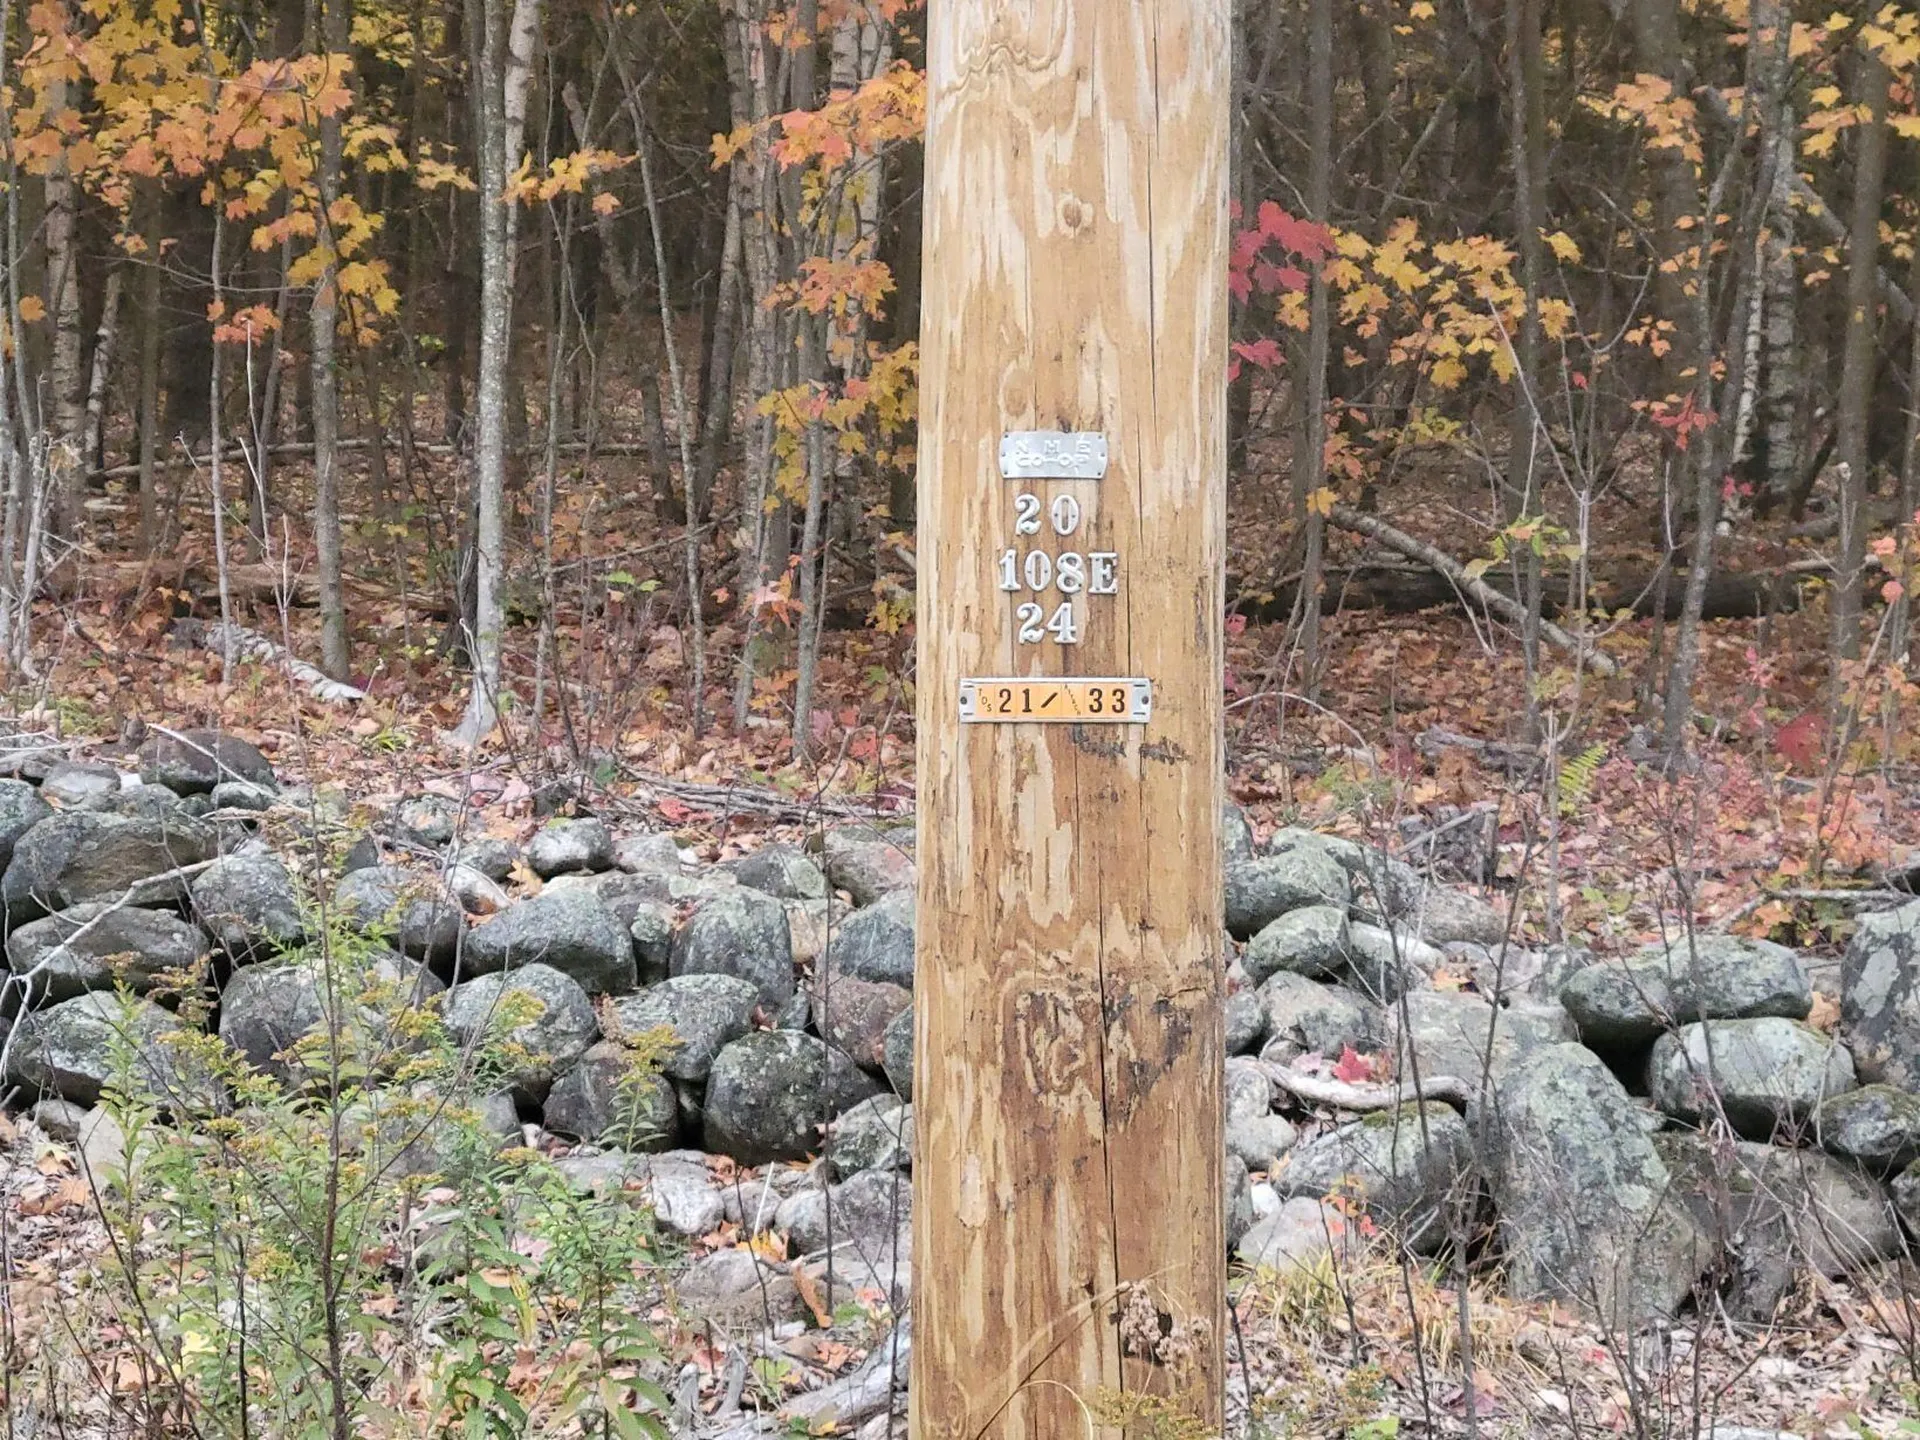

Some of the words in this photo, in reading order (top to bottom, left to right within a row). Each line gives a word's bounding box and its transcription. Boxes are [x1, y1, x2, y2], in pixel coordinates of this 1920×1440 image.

[1014, 493, 1080, 536] 20
[999, 549, 1118, 594] 108E
[1016, 602, 1077, 644] 24
[1088, 688, 1125, 713] 33
